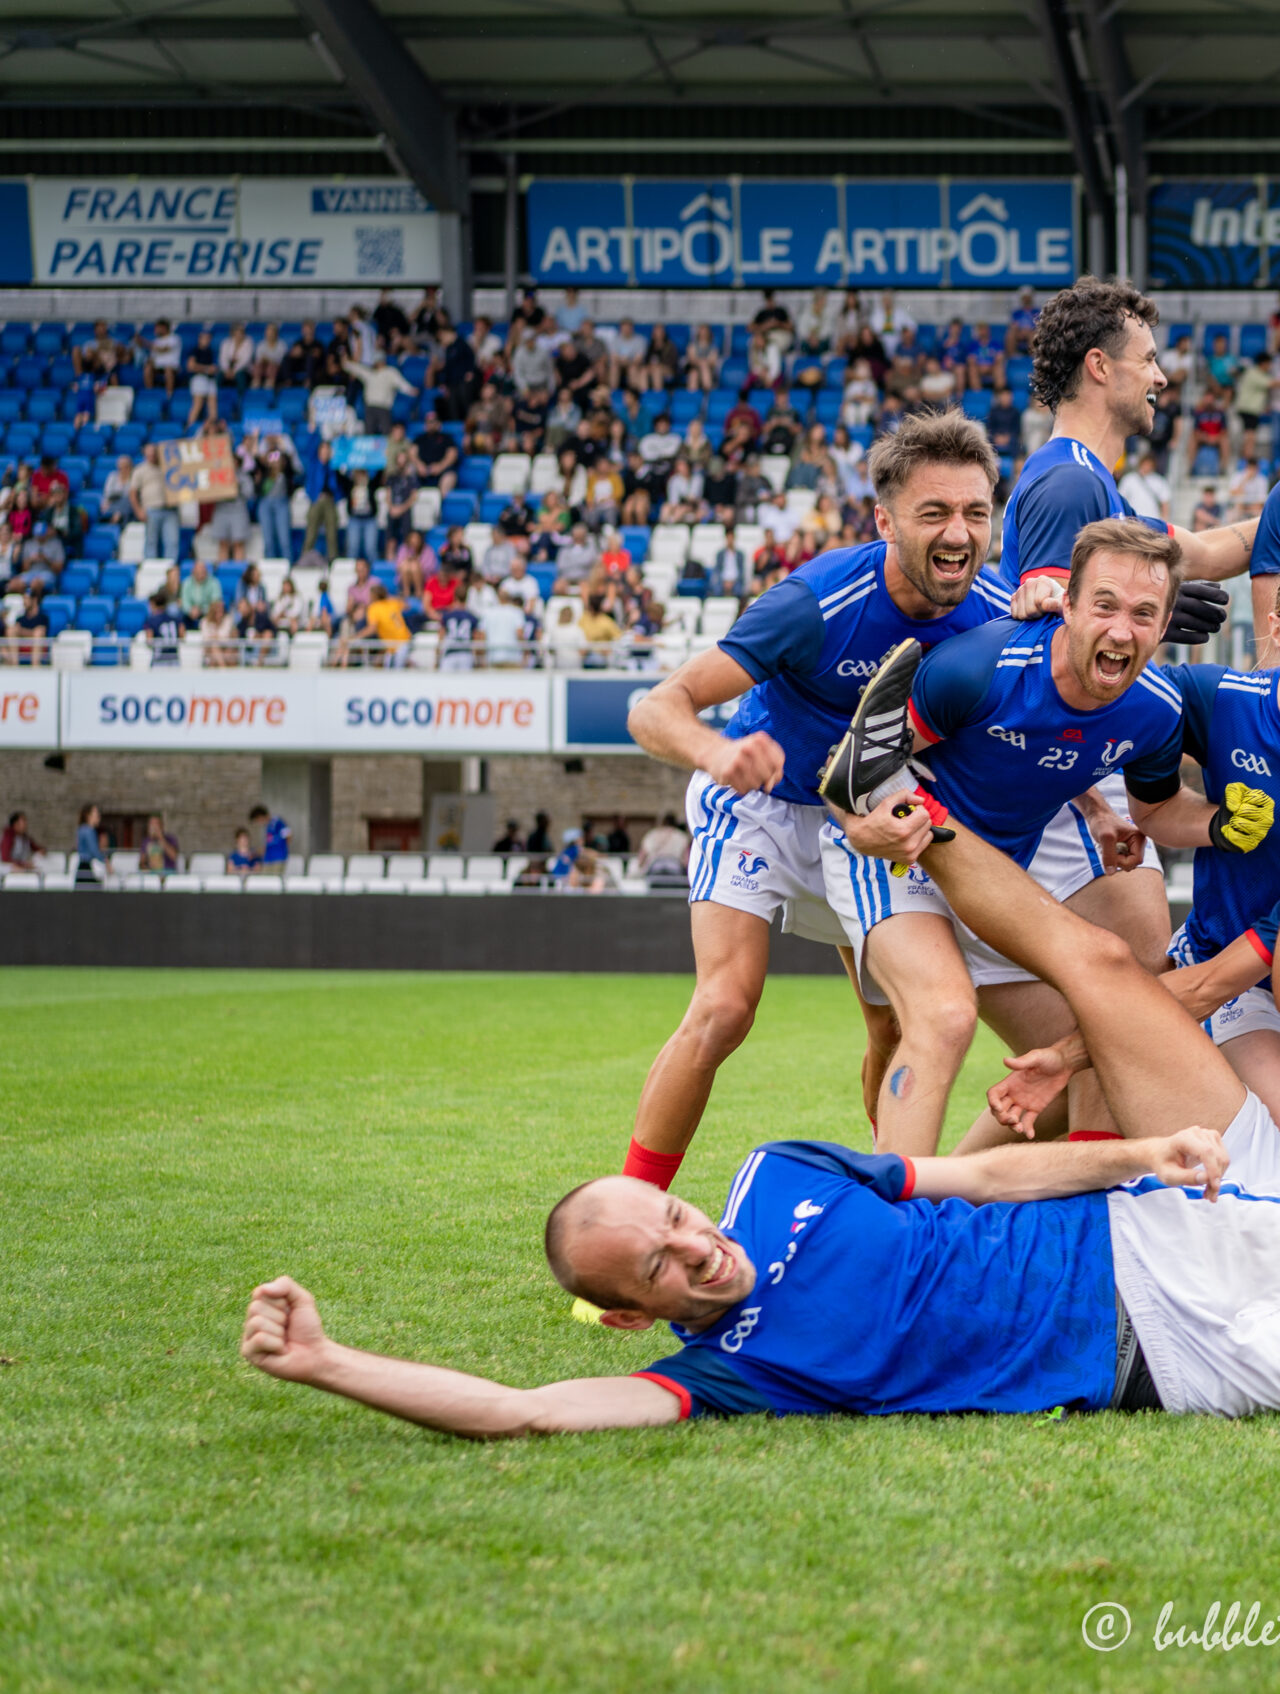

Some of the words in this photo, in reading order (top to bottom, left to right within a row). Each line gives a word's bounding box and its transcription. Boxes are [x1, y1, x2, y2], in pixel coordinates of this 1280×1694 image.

[62, 187, 237, 222] FRANCE
[541, 194, 792, 275] ARTIPÔLE
[816, 194, 1070, 275] ARTIPÔLE
[49, 239, 322, 277] PARE-BRISE
[100, 693, 286, 727] socomore
[346, 694, 533, 728] socomore
[987, 725, 1026, 750] GAA
[1037, 747, 1079, 771] 23
[1231, 749, 1272, 777] GAA
[720, 1306, 762, 1353] GAA
